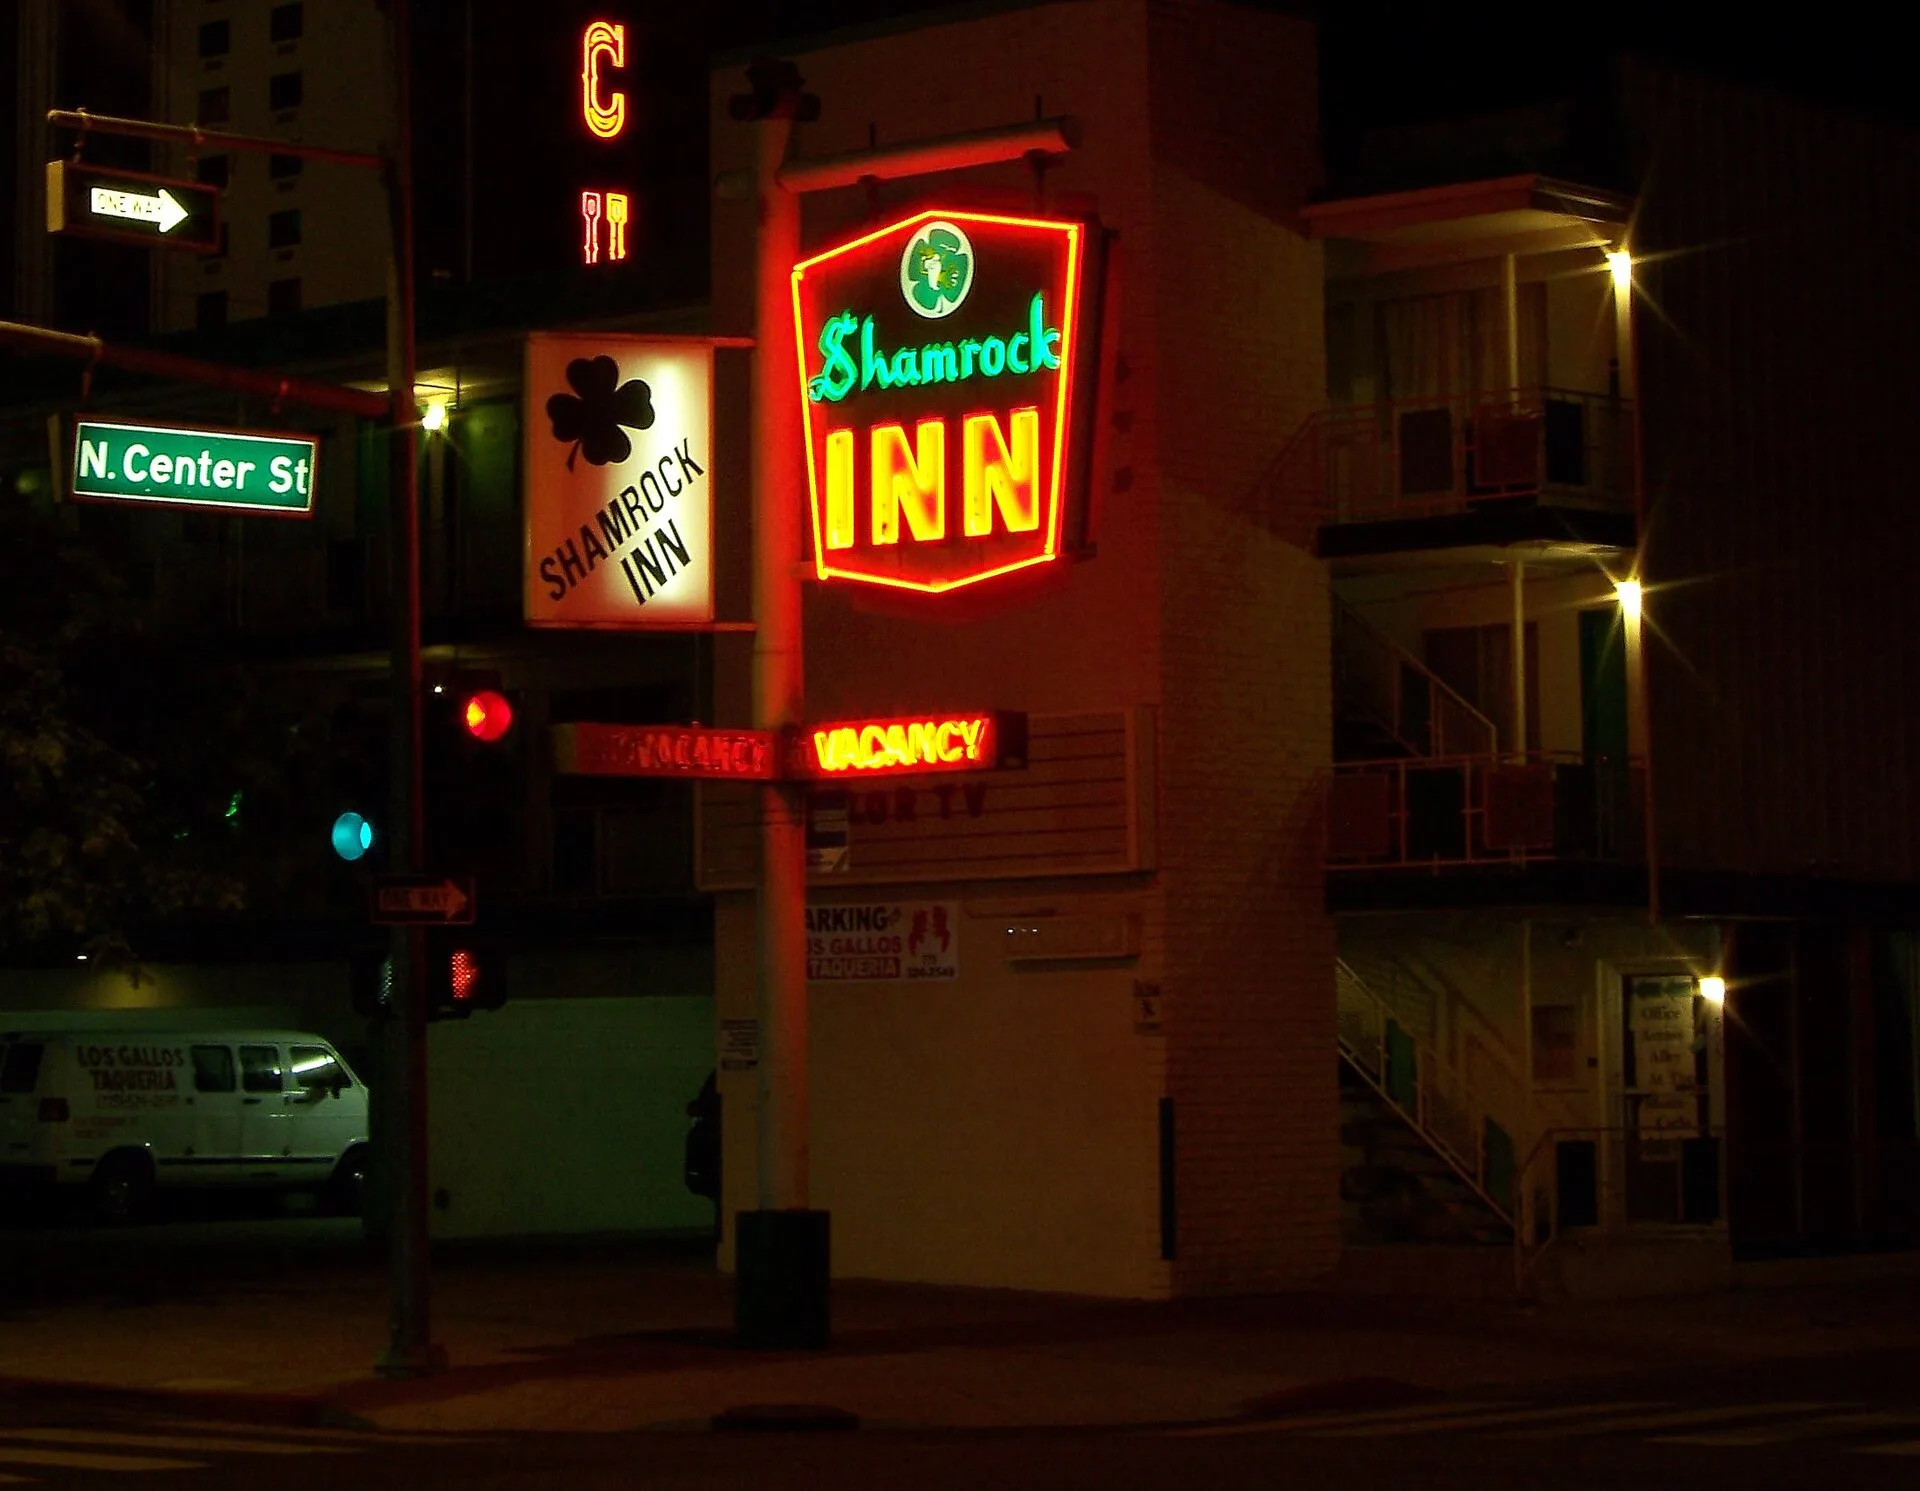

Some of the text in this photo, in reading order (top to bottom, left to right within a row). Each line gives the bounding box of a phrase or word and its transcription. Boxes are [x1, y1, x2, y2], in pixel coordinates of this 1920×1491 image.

[808, 290, 1062, 402] Shamrock
[122, 443, 256, 490] Center
[268, 455, 309, 494] St
[826, 406, 1039, 550] INN
[540, 437, 705, 602] SHAMROCK
[620, 518, 692, 606] INN
[813, 718, 985, 772] VACANCY
[848, 783, 987, 825] LOR TV
[804, 905, 889, 932] ARKING
[804, 935, 902, 955] OS GALLOS
[808, 957, 897, 978] TAQUERIA
[77, 1045, 185, 1067] LOS GALLOS
[89, 1069, 177, 1091] TAQUERIA
